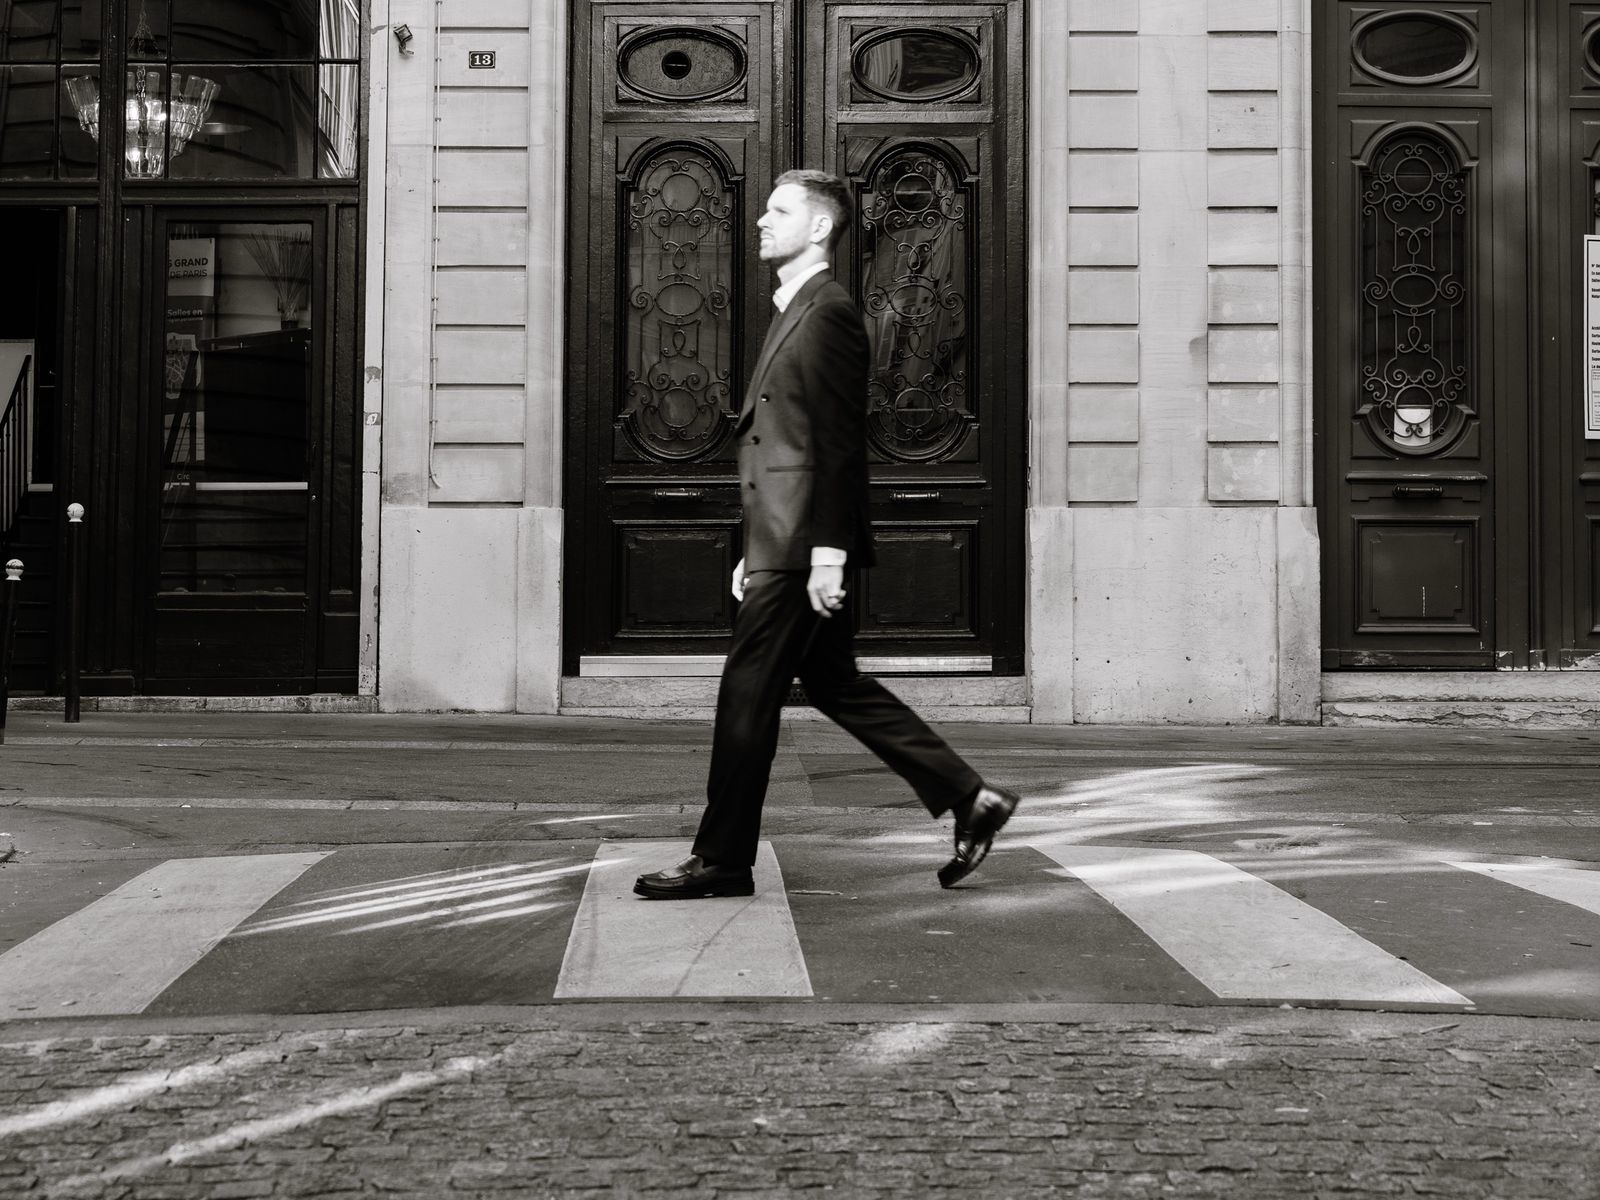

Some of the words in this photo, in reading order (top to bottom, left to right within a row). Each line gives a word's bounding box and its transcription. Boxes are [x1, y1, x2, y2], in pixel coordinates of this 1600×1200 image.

[474, 54, 491, 65] 13
[174, 257, 209, 267] GRAND
[183, 269, 208, 278] PARIS
